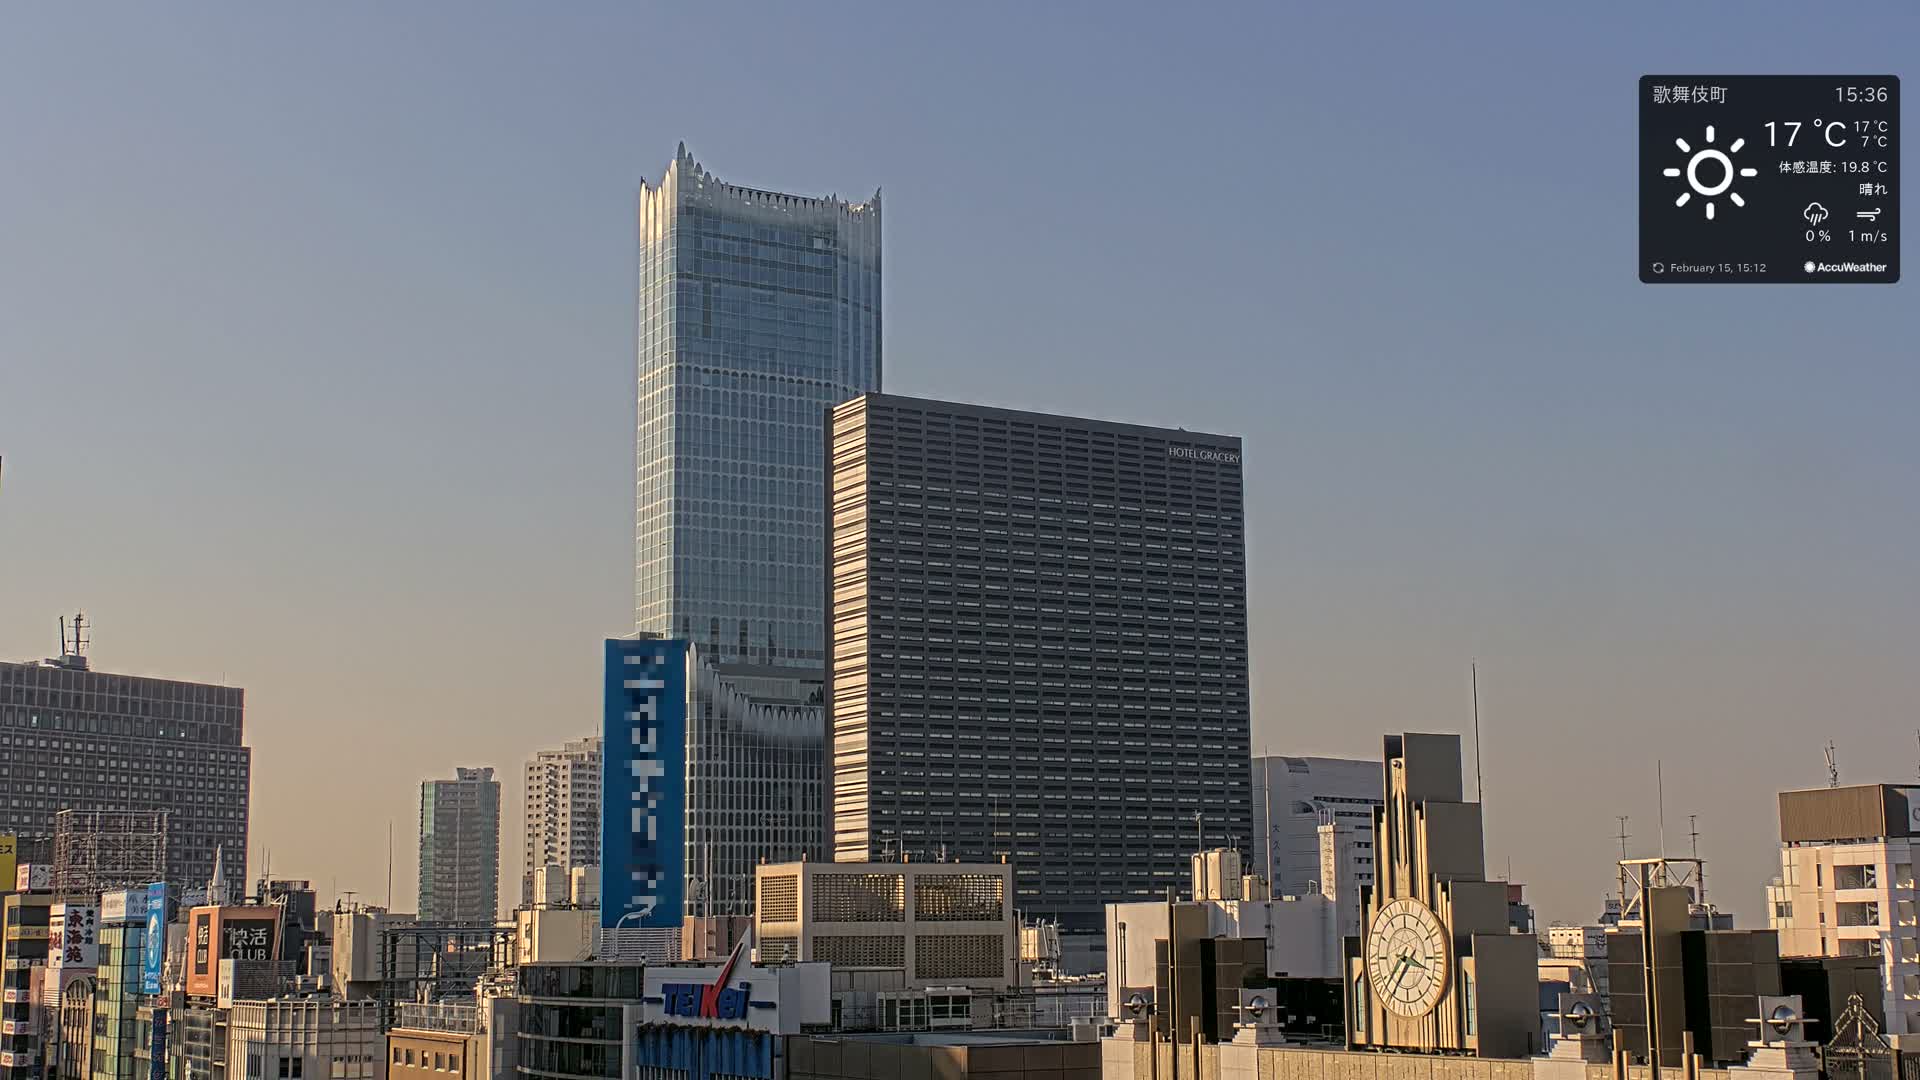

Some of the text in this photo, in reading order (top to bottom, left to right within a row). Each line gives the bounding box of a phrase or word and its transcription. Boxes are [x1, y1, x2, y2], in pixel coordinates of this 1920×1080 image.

[1168, 447, 1241, 464] HOTEL GRACERY
[66, 909, 84, 963] 東海苑
[231, 927, 268, 947] 快活
[231, 948, 267, 961] CLUB
